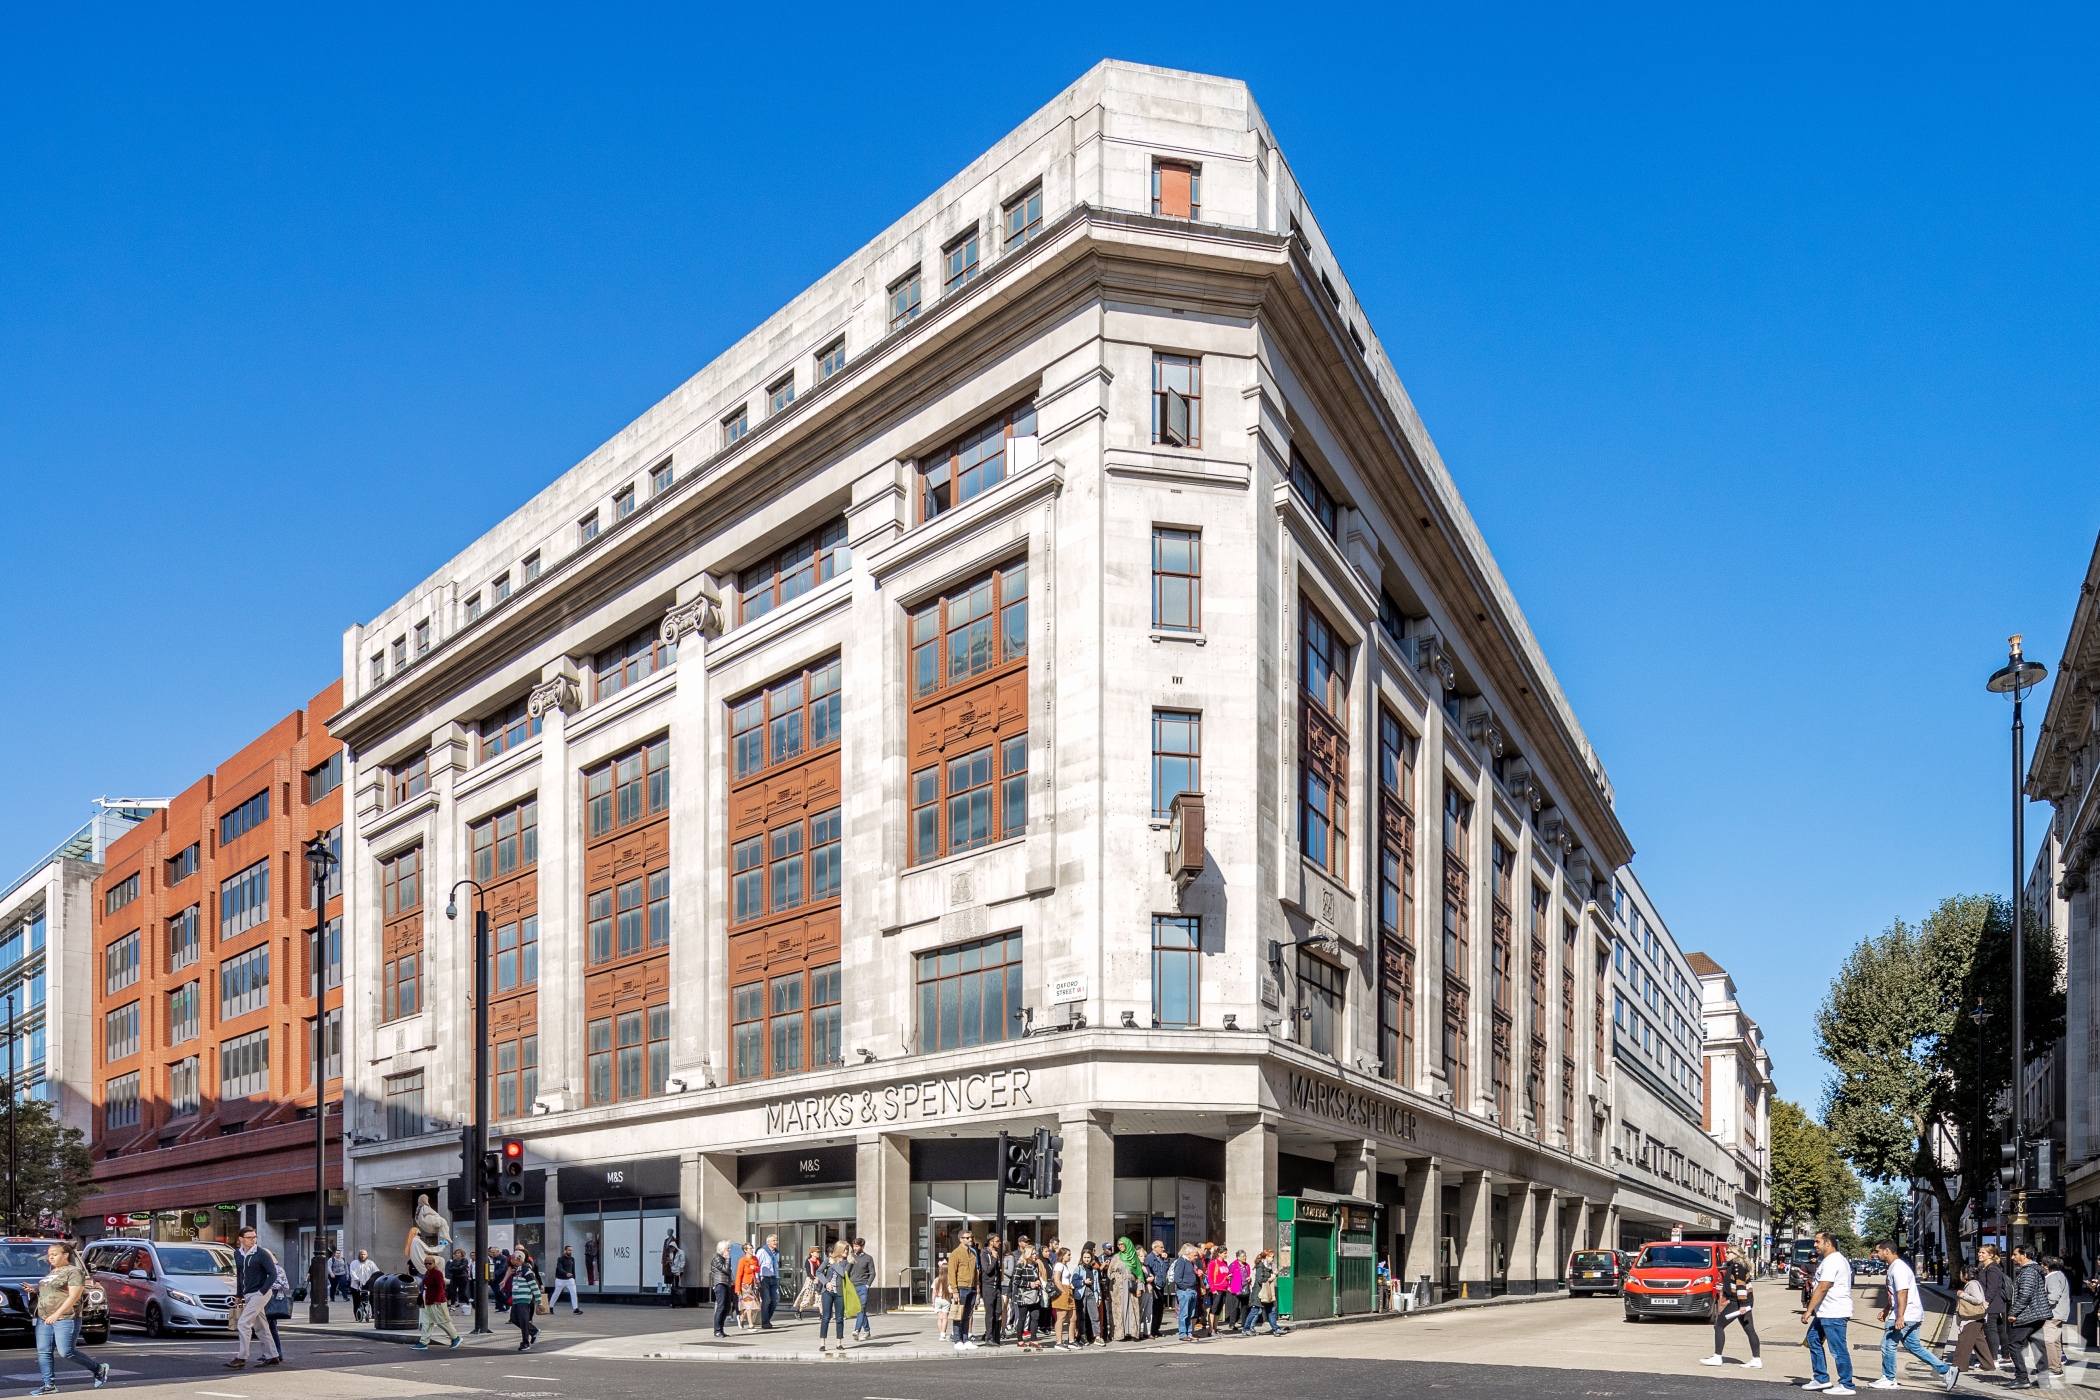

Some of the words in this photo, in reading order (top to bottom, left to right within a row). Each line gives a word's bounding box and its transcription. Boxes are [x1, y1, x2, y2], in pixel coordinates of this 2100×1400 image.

[1056, 981, 1078, 989] OXFORD
[1056, 988, 1076, 996] STREET
[765, 1092, 854, 1135] MARKS
[861, 1090, 878, 1123] &
[883, 1067, 1032, 1120] SPENCER
[1289, 1071, 1346, 1121] MARKS
[1347, 1093, 1357, 1125] &
[1358, 1096, 1417, 1142] SPENCER
[800, 1159, 820, 1172] M&S
[607, 1171, 624, 1183] M&S
[613, 1246, 630, 1259] M&S
